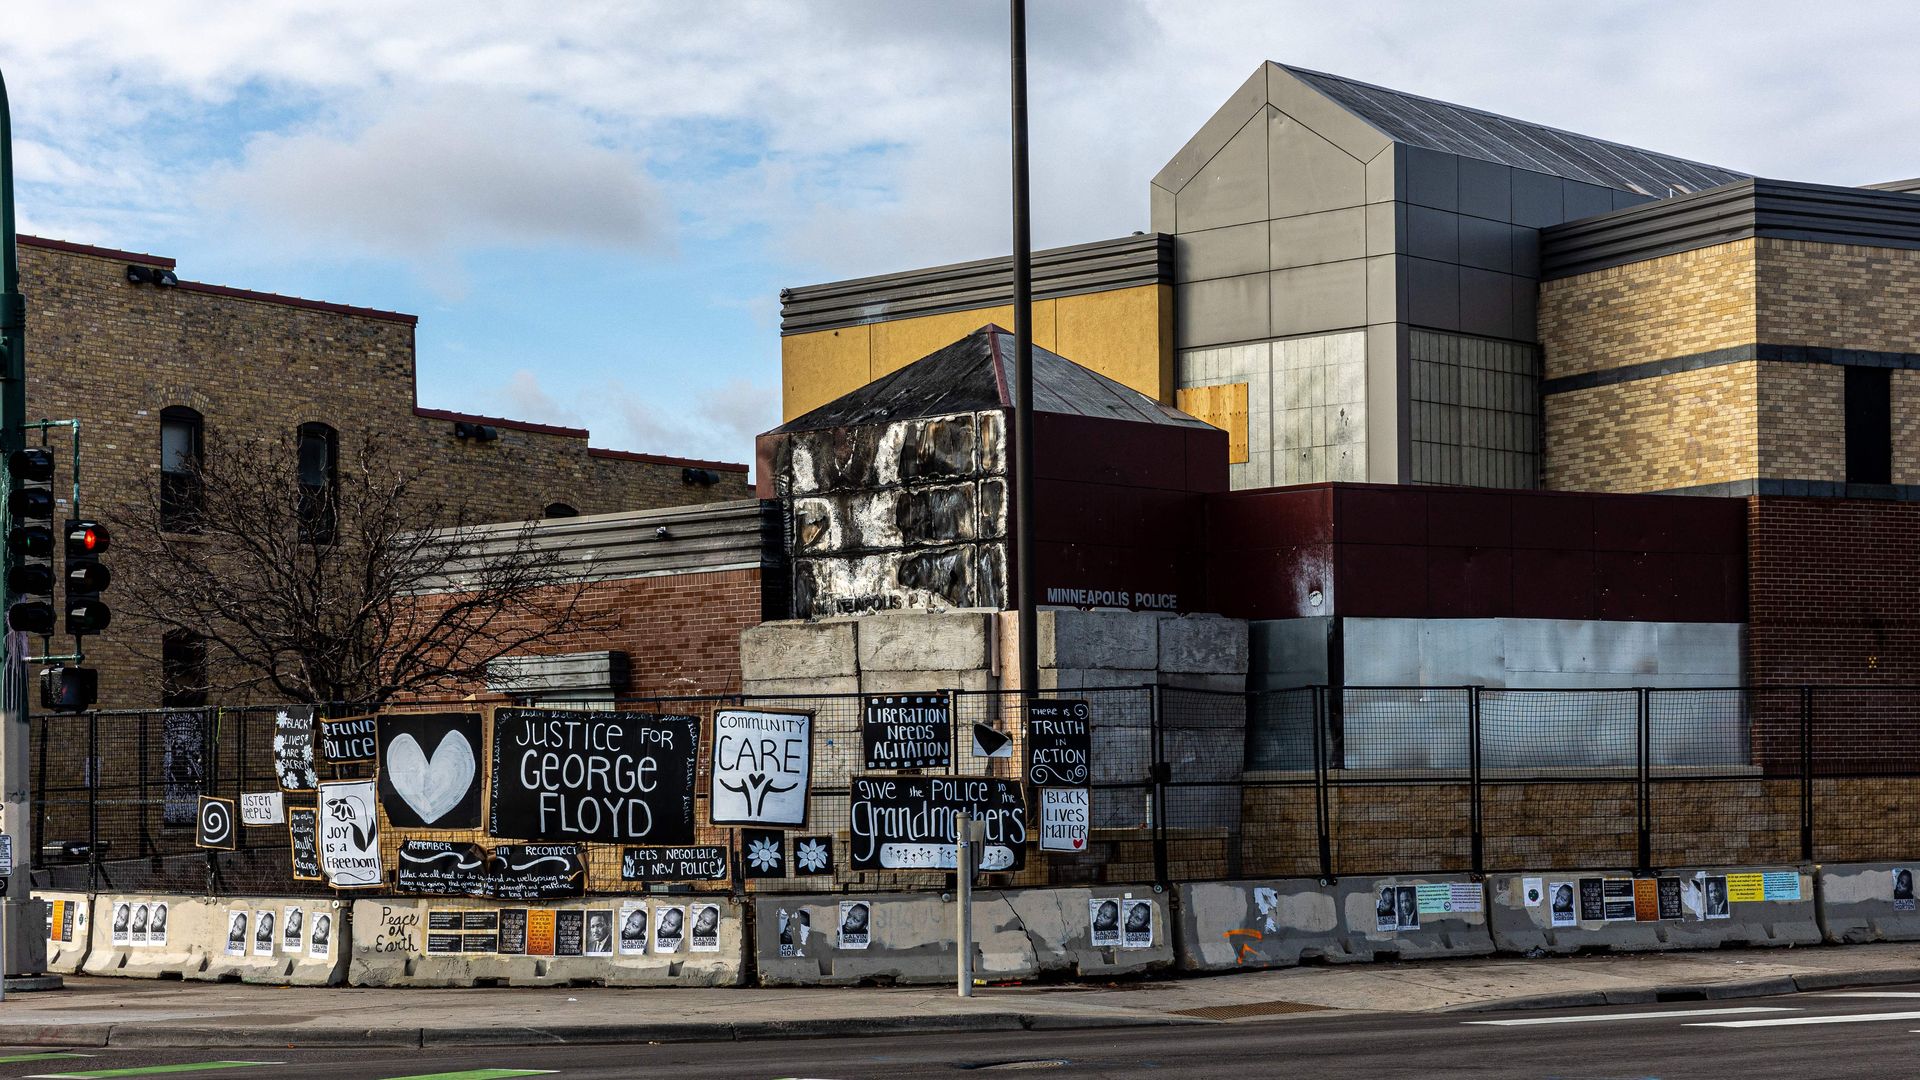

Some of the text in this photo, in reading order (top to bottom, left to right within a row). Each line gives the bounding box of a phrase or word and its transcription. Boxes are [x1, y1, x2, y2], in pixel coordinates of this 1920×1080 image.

[1047, 588, 1177, 609] MINNEAPOLIS POLICE
[286, 718, 309, 729] BLACK
[719, 714, 806, 734] COMMUNITY
[868, 707, 947, 724] LIBERATION
[1031, 720, 1085, 735] TRUTH
[640, 727, 674, 751] FOR
[1055, 738, 1067, 746] IN
[719, 735, 802, 774] CARE
[874, 741, 949, 760] AGITATION
[1033, 748, 1086, 764] ACTION
[540, 792, 653, 838] FLOYD
[327, 826, 349, 840] JOY
[380, 906, 420, 927] Peace
[375, 934, 418, 953] Earth
